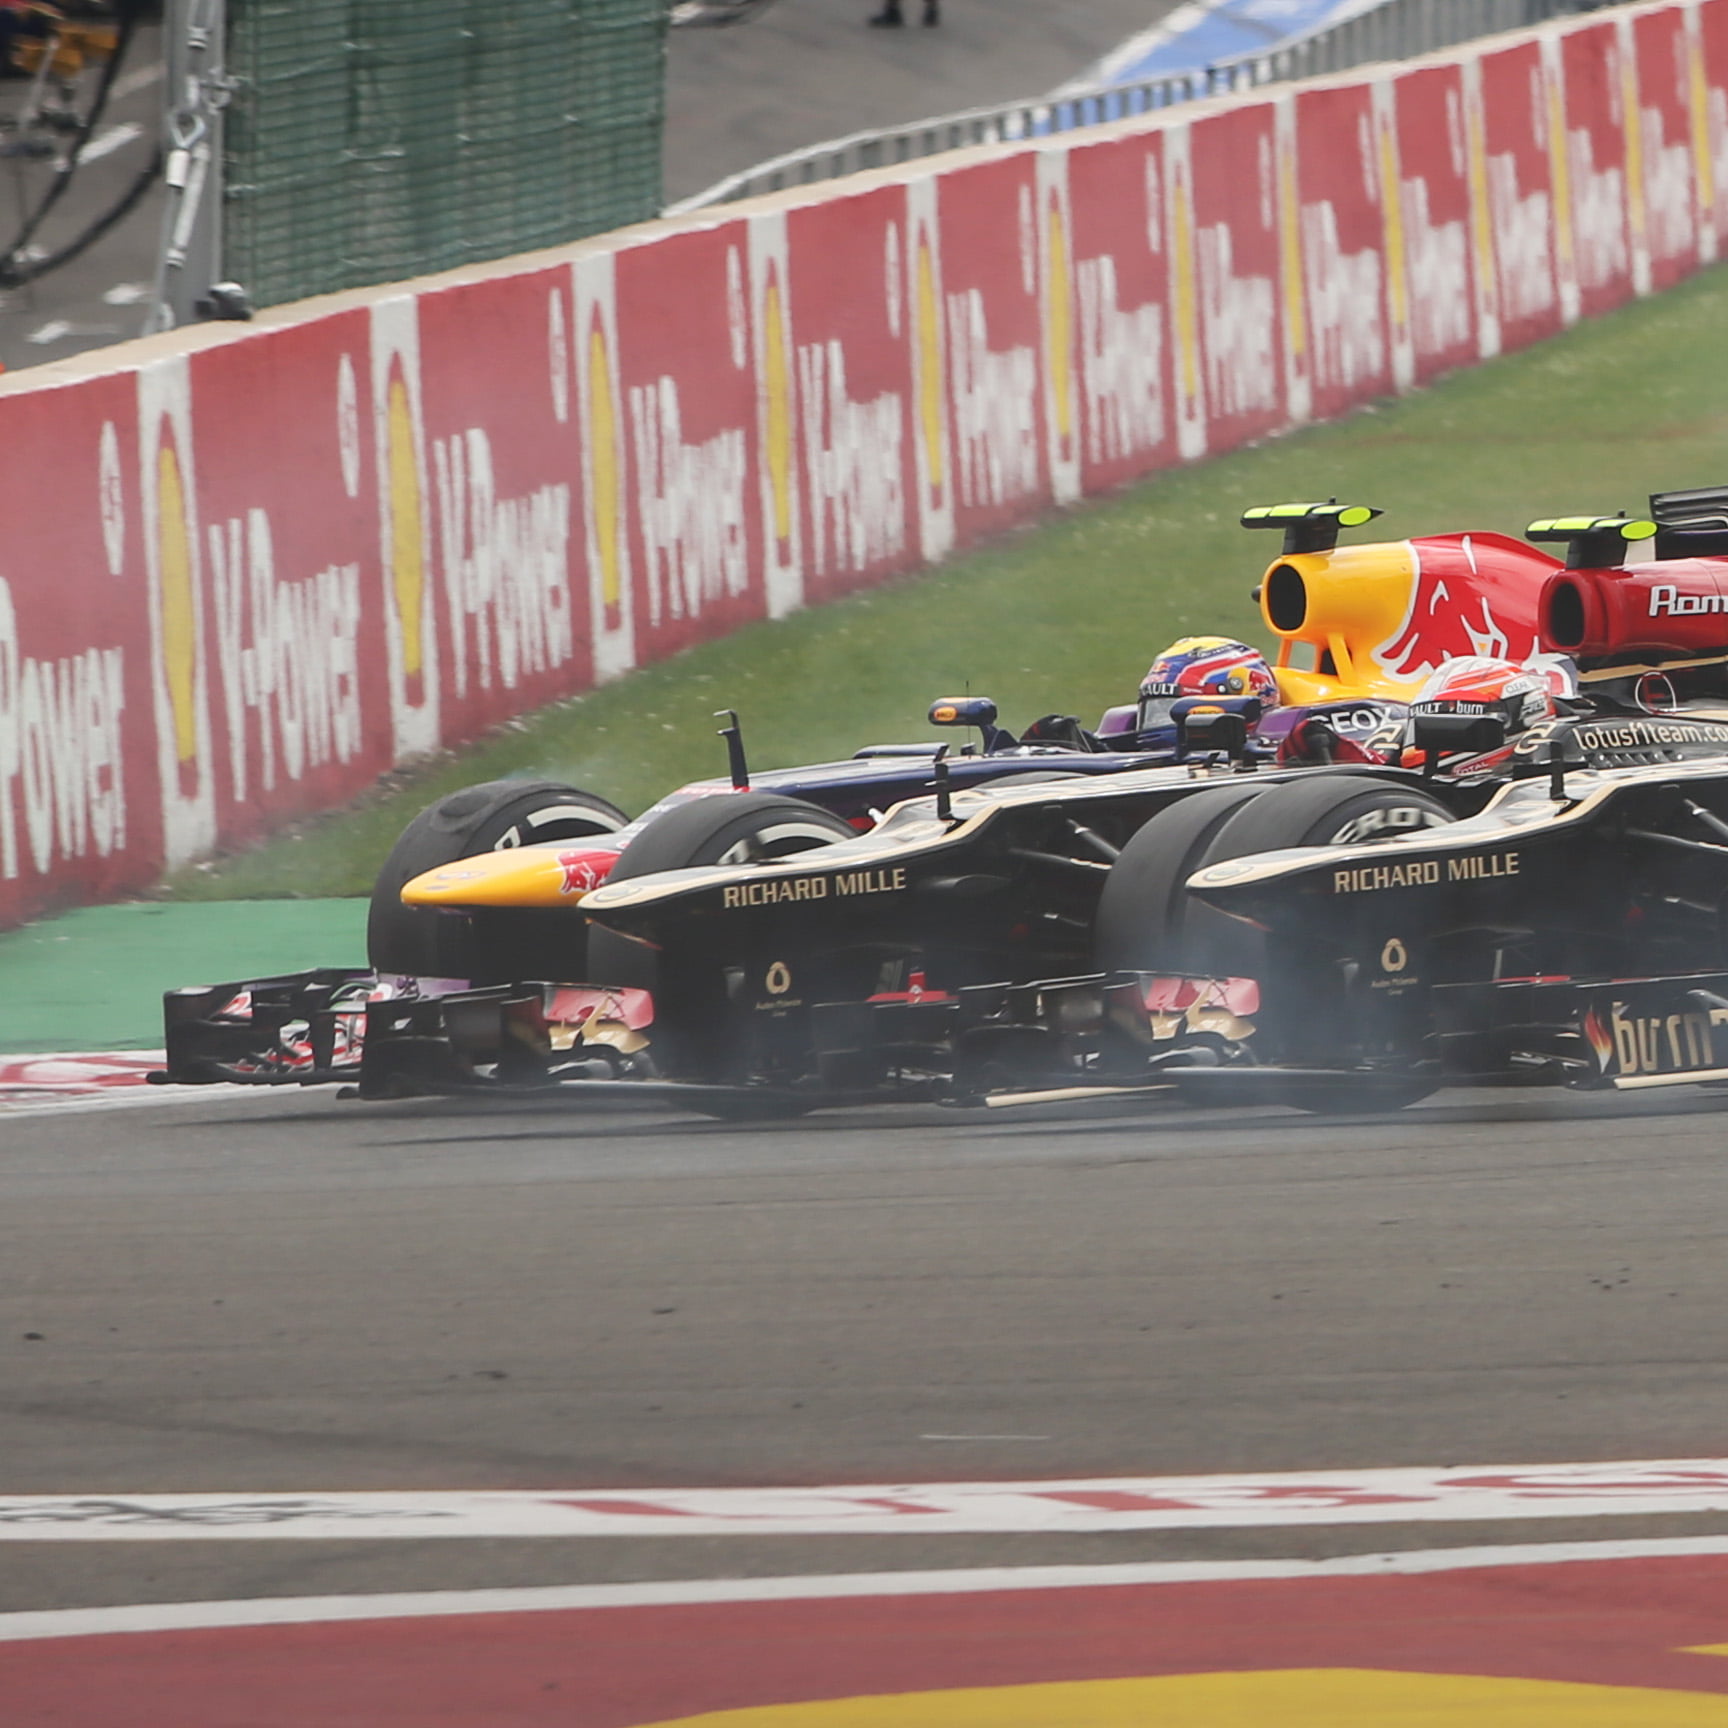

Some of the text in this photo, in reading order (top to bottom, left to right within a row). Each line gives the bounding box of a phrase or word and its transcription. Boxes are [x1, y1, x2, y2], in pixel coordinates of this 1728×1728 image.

[207, 507, 362, 803] V-Power
[1456, 701, 1485, 716] burn
[723, 868, 907, 909] RICHARD MILLE
[1333, 852, 1520, 895] RICHARD MILLE
